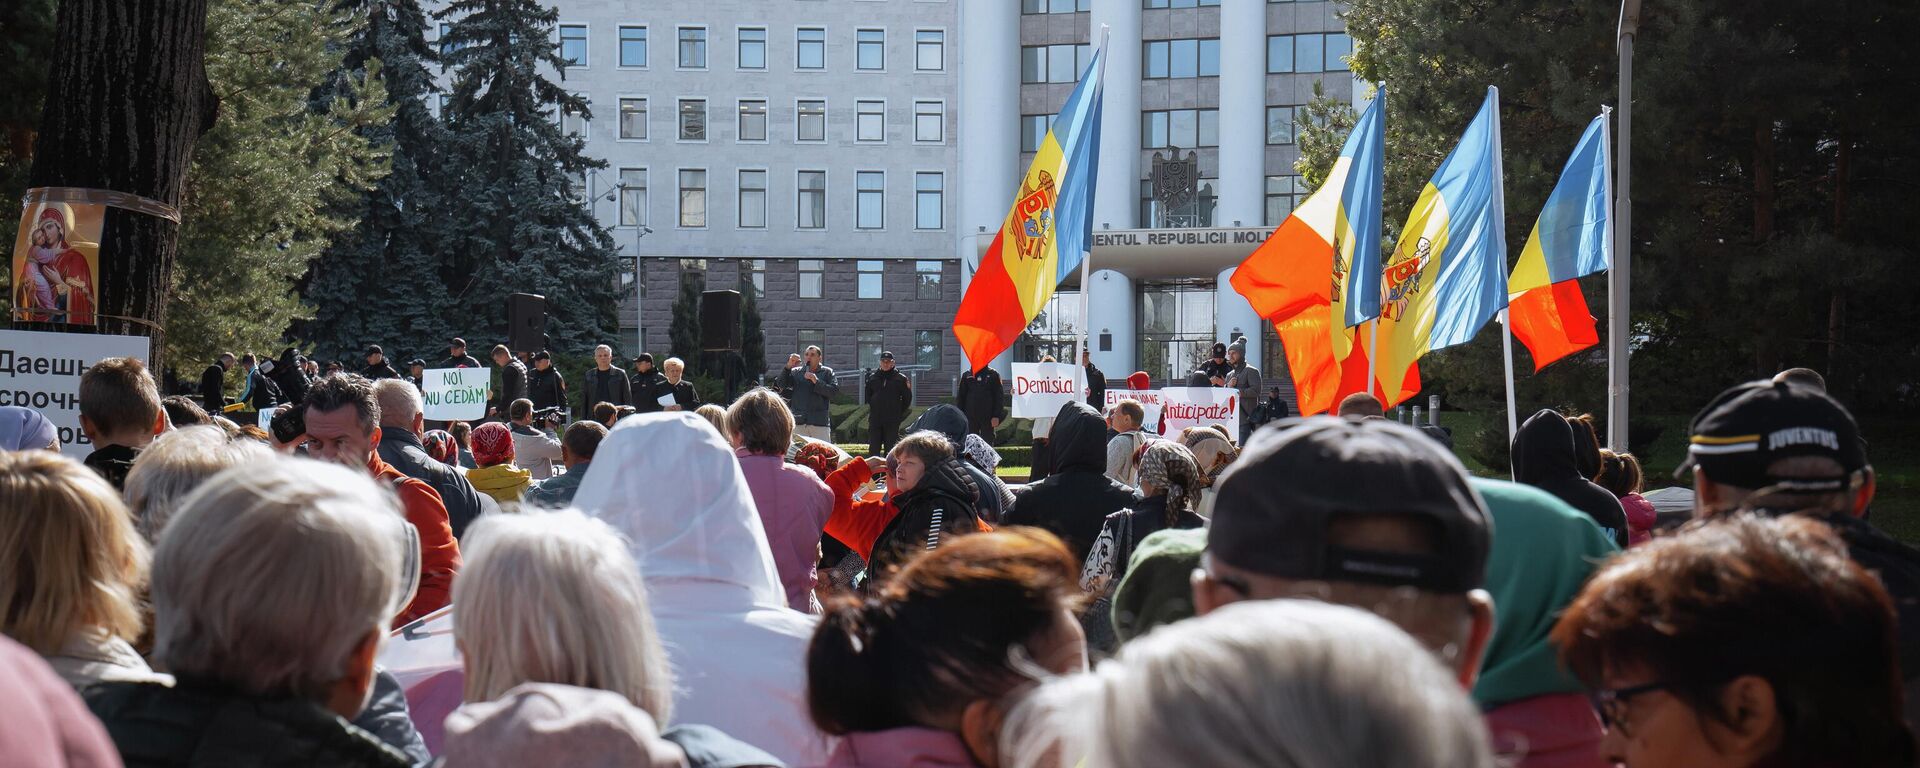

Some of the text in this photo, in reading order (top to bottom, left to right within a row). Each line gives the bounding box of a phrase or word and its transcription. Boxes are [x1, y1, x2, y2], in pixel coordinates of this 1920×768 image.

[1147, 231, 1227, 246] REPUBLICII
[1017, 375, 1074, 396] Demisia
[425, 391, 440, 406] NU
[1768, 427, 1840, 451] JUVENTUS
